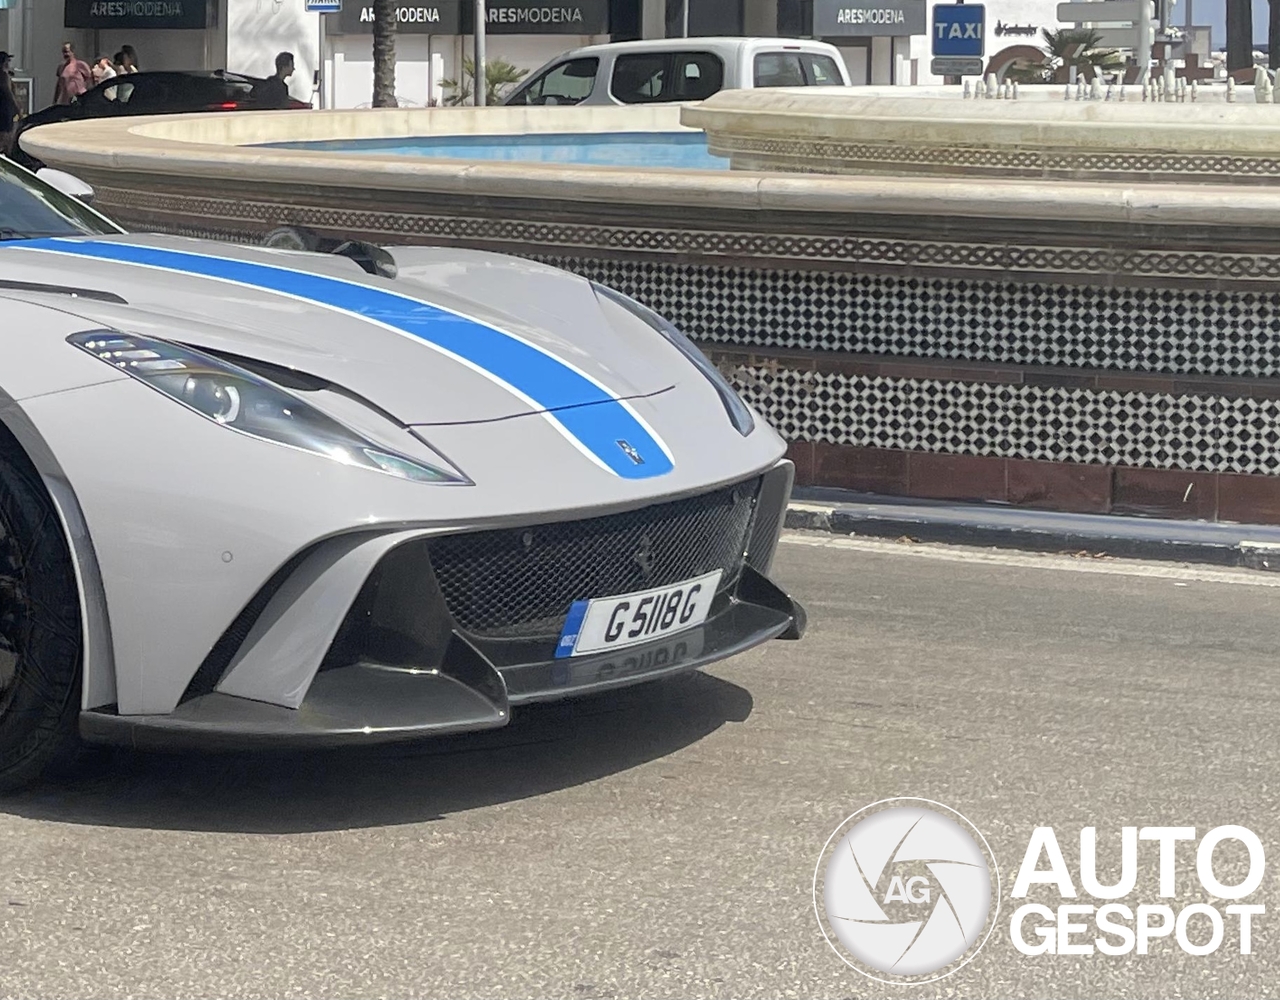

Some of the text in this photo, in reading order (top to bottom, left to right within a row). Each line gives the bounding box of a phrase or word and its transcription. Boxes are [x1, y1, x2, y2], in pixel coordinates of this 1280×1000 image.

[359, 7, 440, 22] ARODENA
[837, 9, 905, 24] ARESMODENA
[935, 22, 982, 39] TAXI
[604, 601, 630, 642] G
